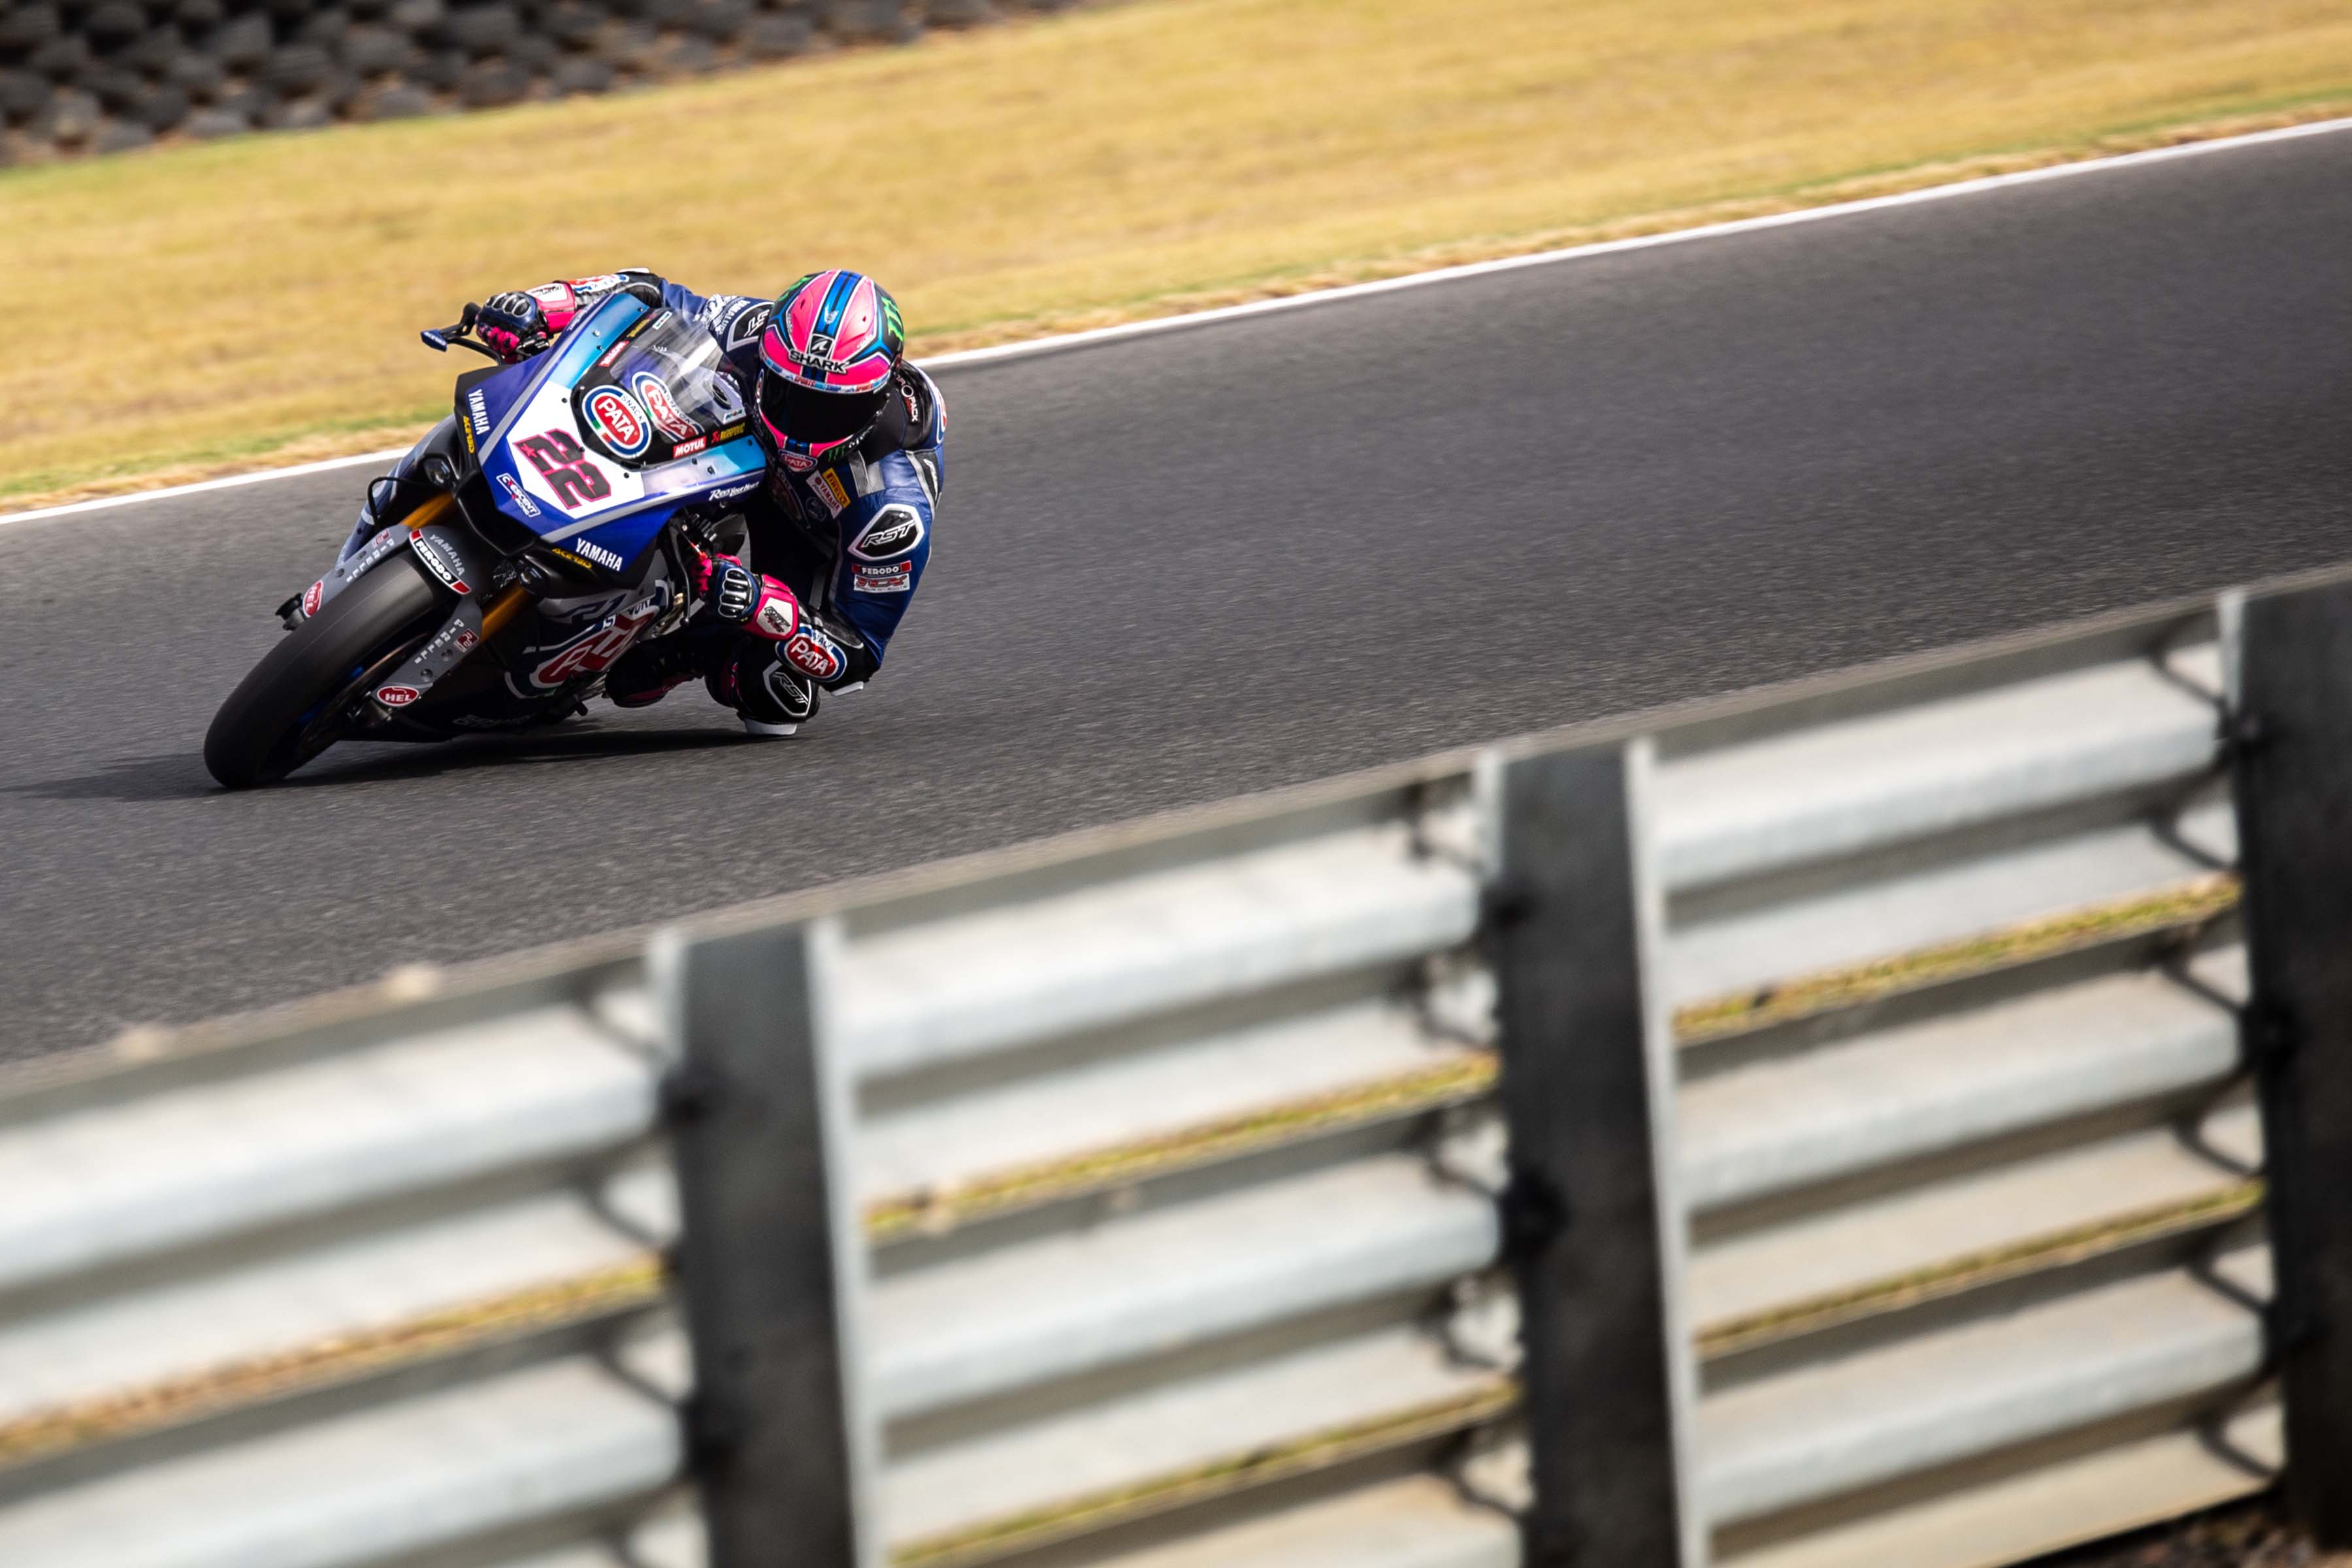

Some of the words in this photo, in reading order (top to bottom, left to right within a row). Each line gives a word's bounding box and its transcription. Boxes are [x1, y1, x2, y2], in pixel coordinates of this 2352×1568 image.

[790, 351, 845, 374] SHARK
[468, 389, 490, 435] YAMAHA
[598, 398, 636, 442] PATA
[621, 395, 643, 421] SNACK
[647, 389, 688, 435] PATA
[674, 439, 705, 457] MOTUL
[513, 427, 612, 510] 22
[819, 483, 841, 512] YAMAHA
[861, 519, 915, 548] RST
[346, 538, 395, 583] PIRELLI
[415, 540, 452, 581] FERODO
[429, 534, 466, 576] YAMAHA
[576, 538, 623, 572] YAMAHA
[862, 566, 899, 575] FERODO
[304, 585, 318, 609] HEL
[414, 619, 465, 664] PIRELLI
[791, 640, 829, 675] PATA
[385, 693, 412, 702] HEL
[773, 672, 809, 705] RST
